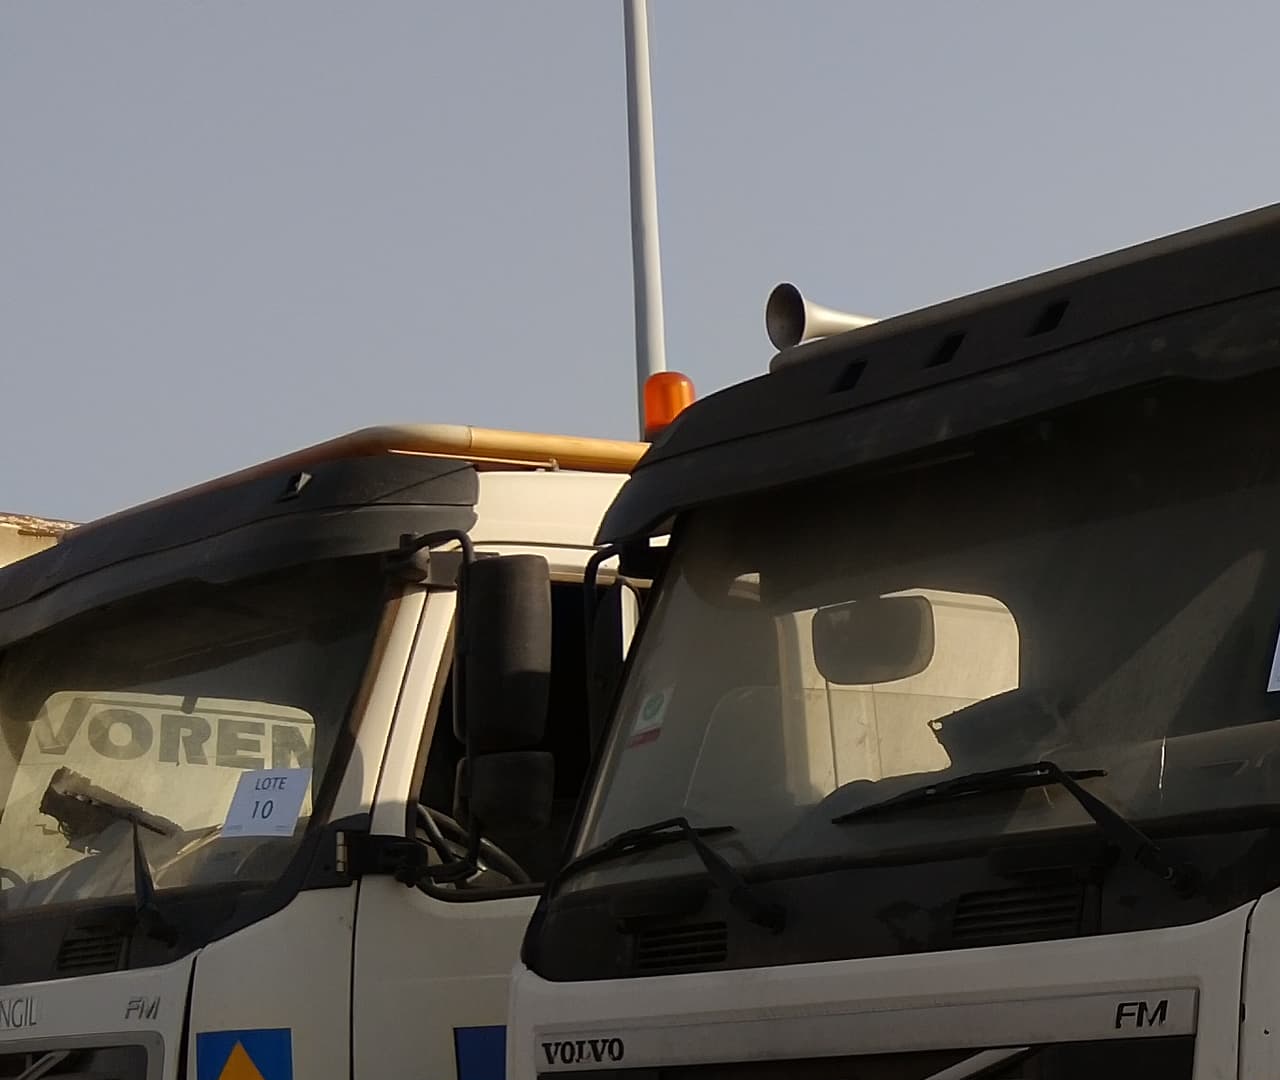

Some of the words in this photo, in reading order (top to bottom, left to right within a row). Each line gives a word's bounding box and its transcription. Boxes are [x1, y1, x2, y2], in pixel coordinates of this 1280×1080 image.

[255, 776, 288, 791] LOTE
[251, 799, 274, 820] 10
[124, 996, 161, 1020] FM
[1115, 1000, 1168, 1030] FM
[541, 1038, 625, 1065] VOLVO
